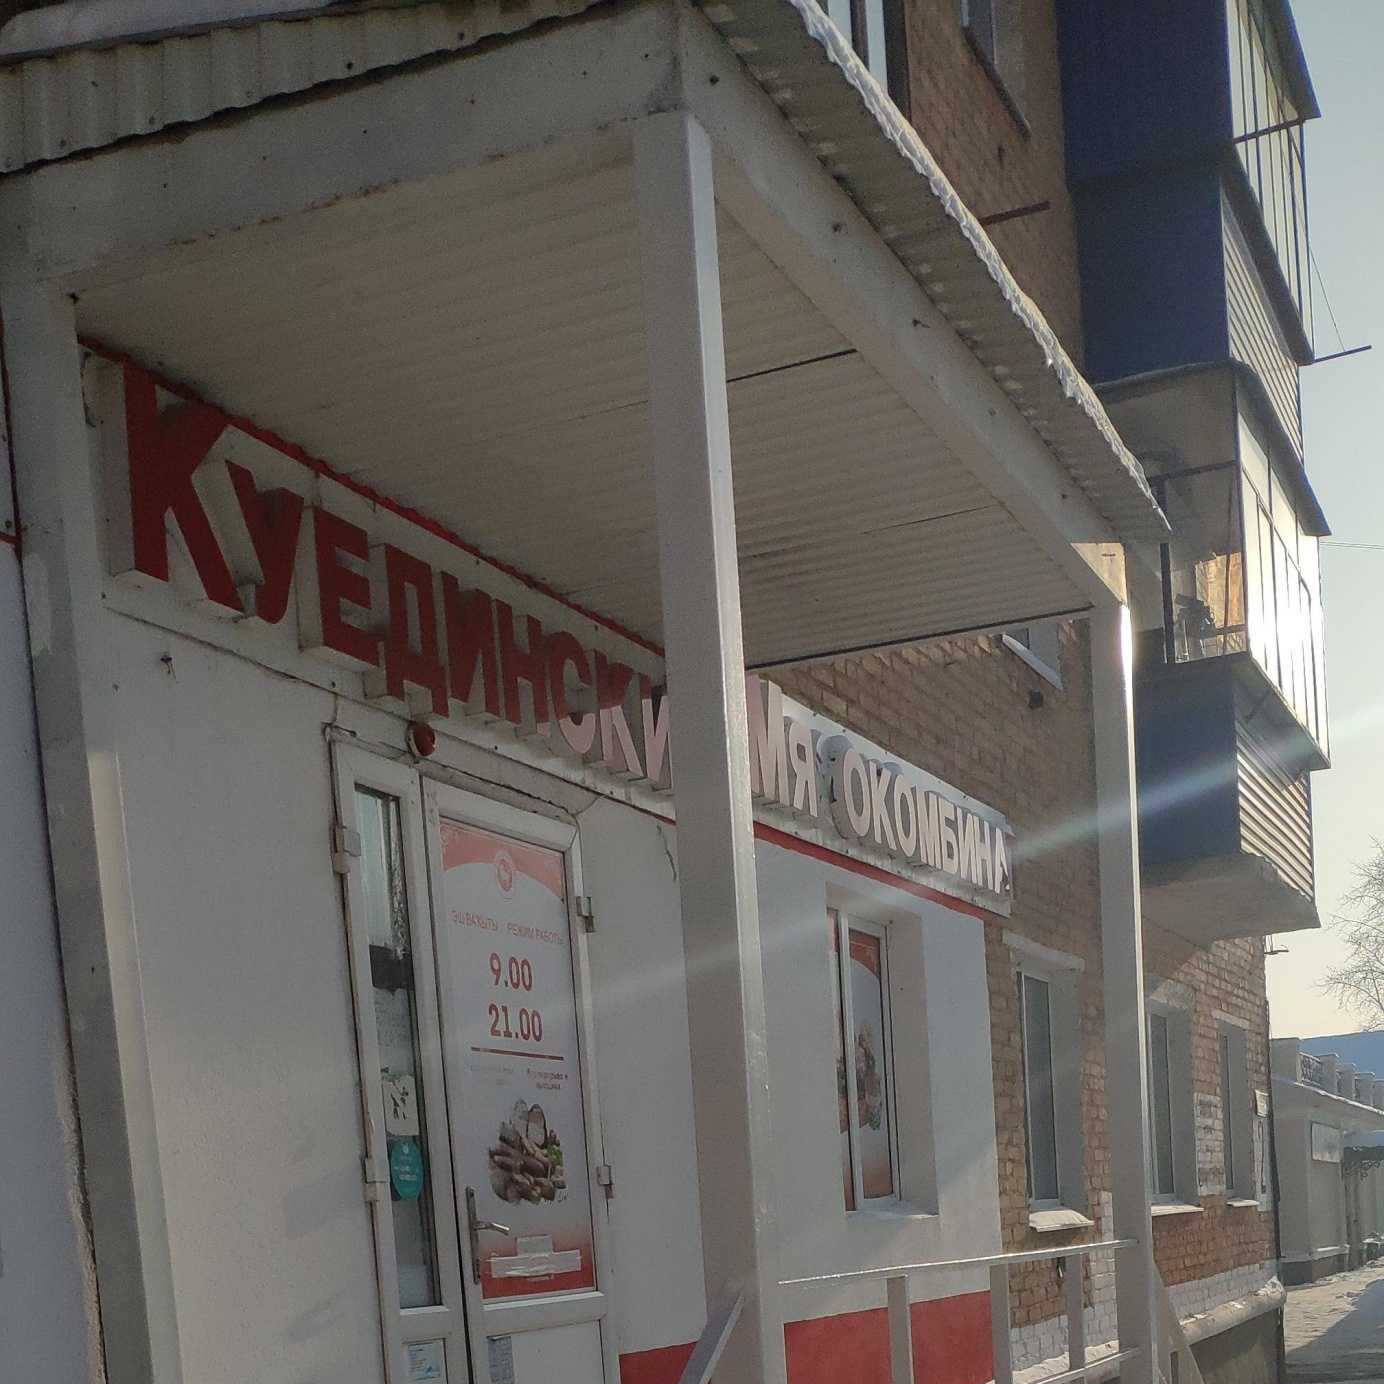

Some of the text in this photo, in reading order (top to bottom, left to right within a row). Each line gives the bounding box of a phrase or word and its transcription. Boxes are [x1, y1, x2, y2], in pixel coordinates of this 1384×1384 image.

[122, 357, 674, 791] КУЕДИНСКИ
[489, 952, 532, 991] 9.00
[488, 1003, 542, 1042] 21.00
